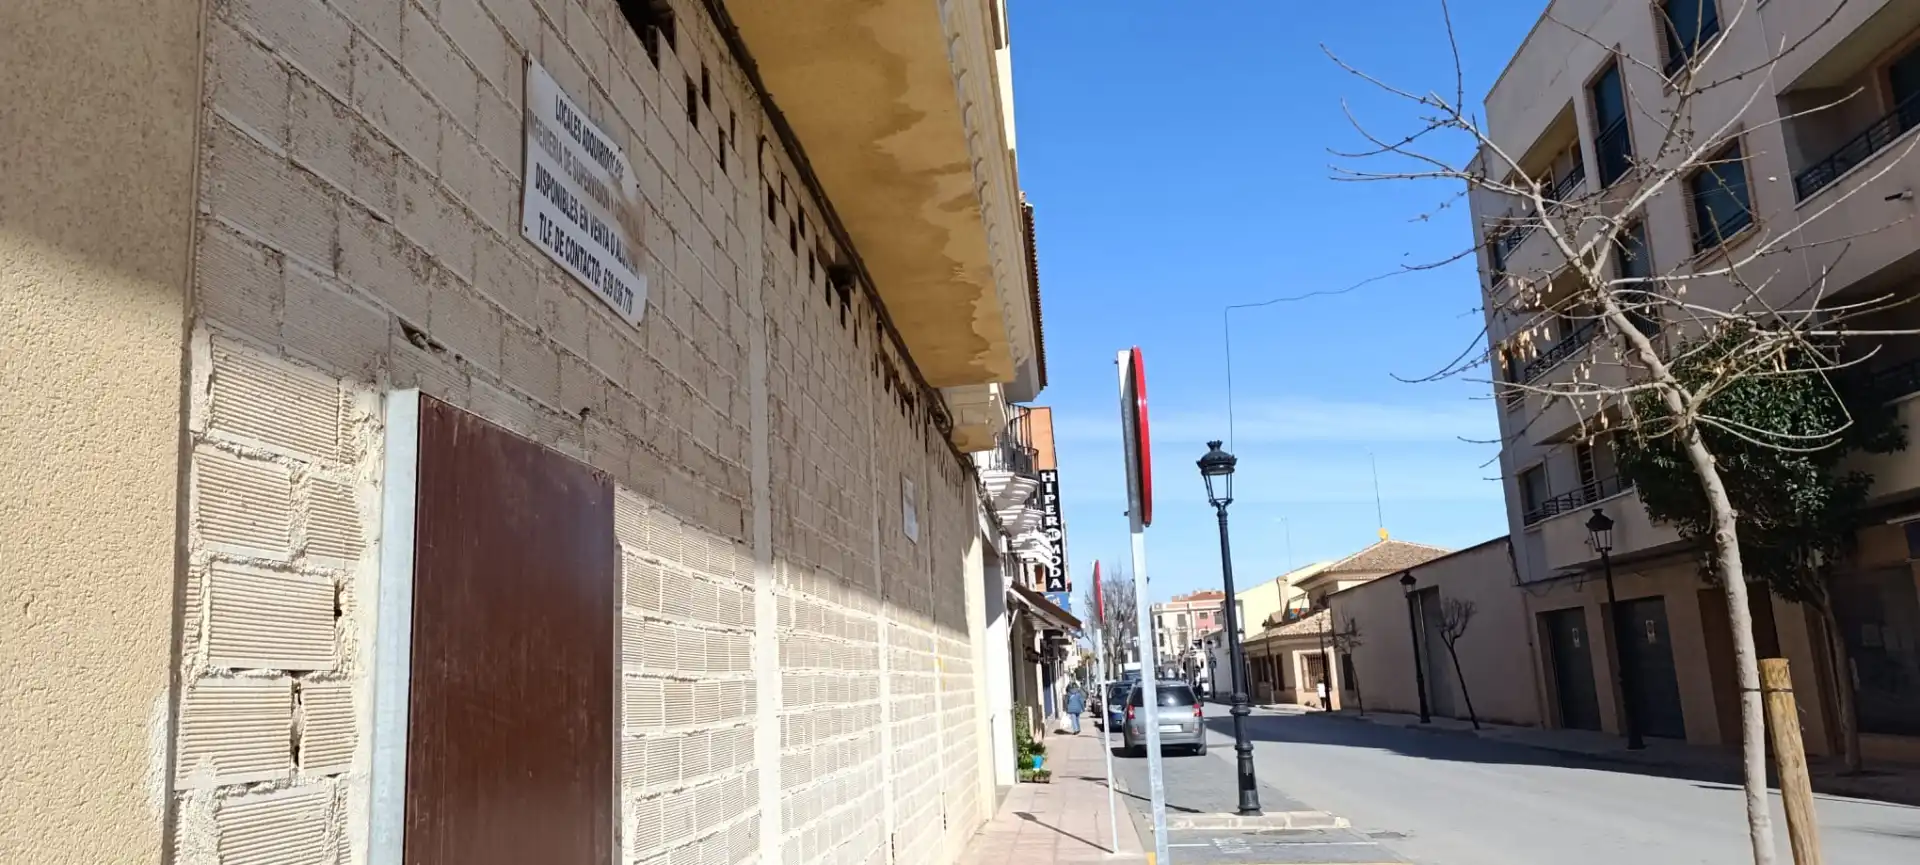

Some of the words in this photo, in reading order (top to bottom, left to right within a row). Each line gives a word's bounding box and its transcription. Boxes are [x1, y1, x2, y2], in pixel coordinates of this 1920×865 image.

[555, 93, 581, 145] LOCALES
[535, 162, 579, 225] DISPONIBLES
[579, 203, 589, 234] EN
[590, 212, 610, 252] VENTA
[539, 211, 553, 249] TLF.
[554, 225, 565, 258] DE
[565, 235, 602, 288] CONTACTO:
[1041, 472, 1060, 526] HIPER
[1049, 543, 1062, 589] MODA
